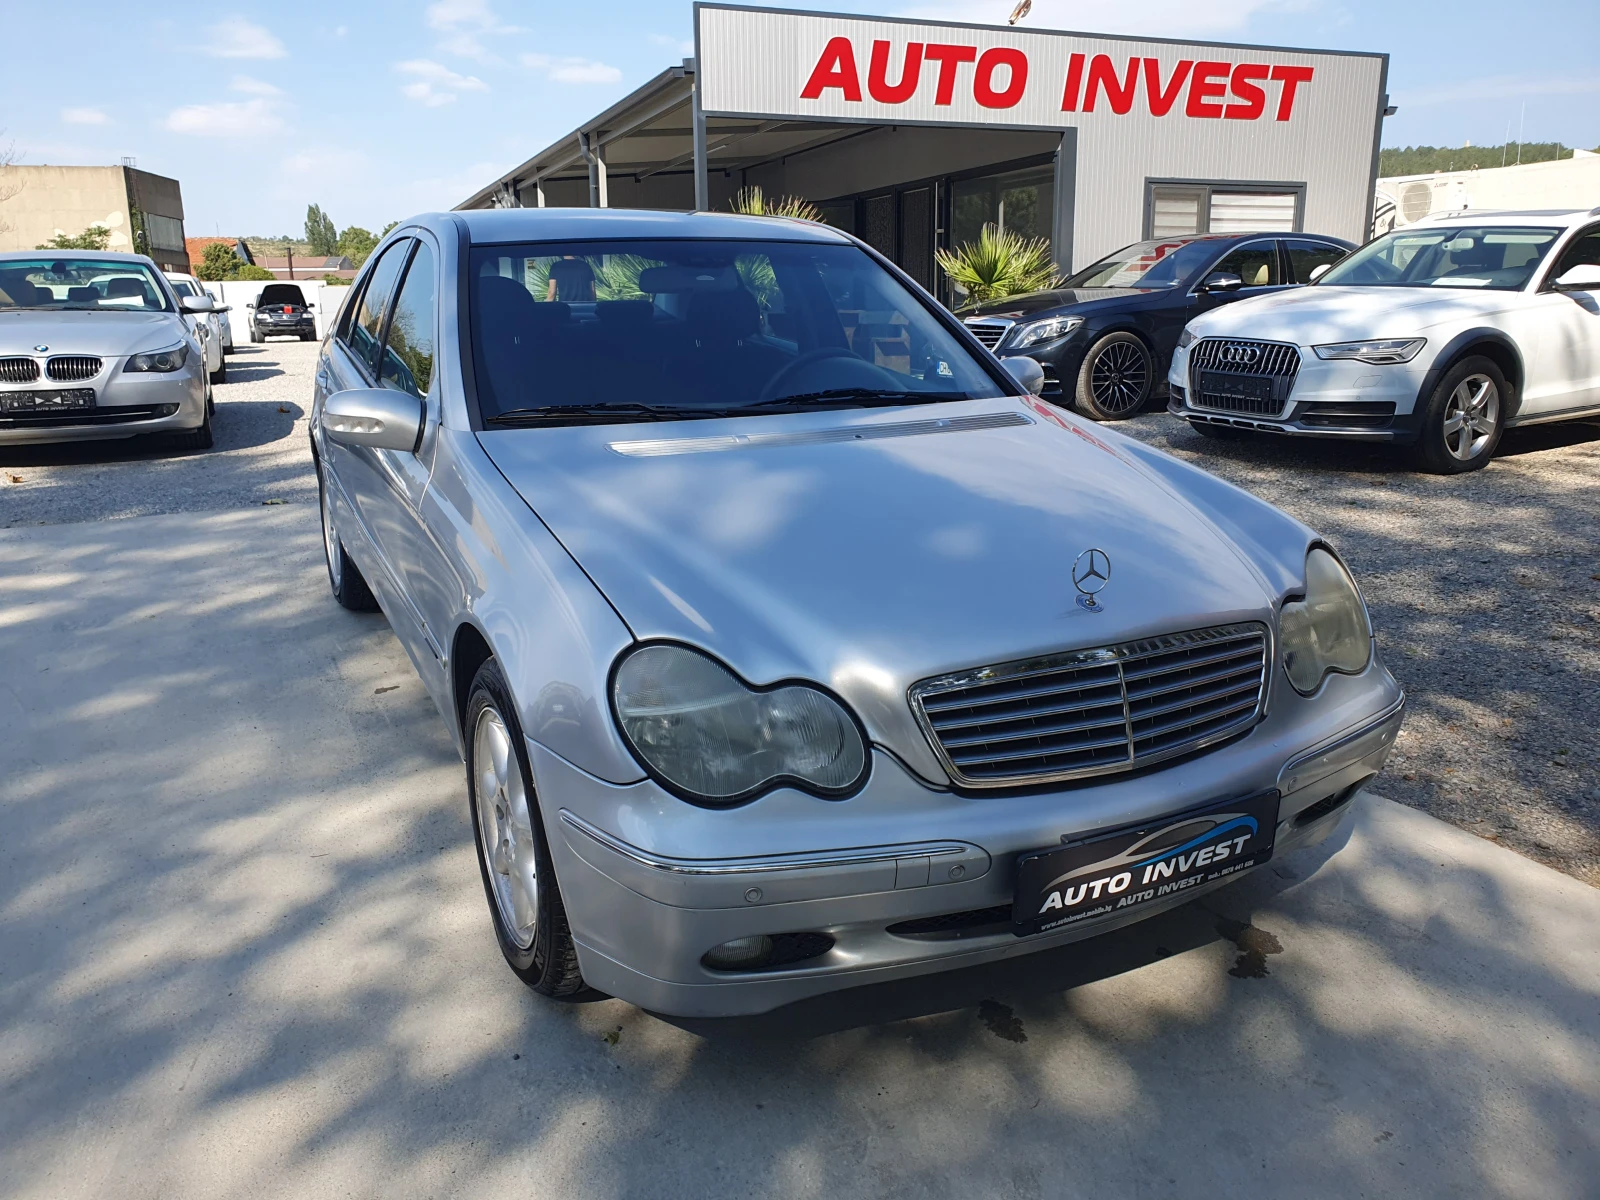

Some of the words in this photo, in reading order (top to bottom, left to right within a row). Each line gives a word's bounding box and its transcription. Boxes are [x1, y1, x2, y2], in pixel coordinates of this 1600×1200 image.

[799, 36, 1029, 110] AUTO
[1060, 53, 1314, 122] INVEST
[1038, 872, 1132, 914] AUTO
[1142, 834, 1251, 885] INVEST
[1116, 889, 1155, 908] AUTO
[1157, 873, 1205, 896] INVEST
